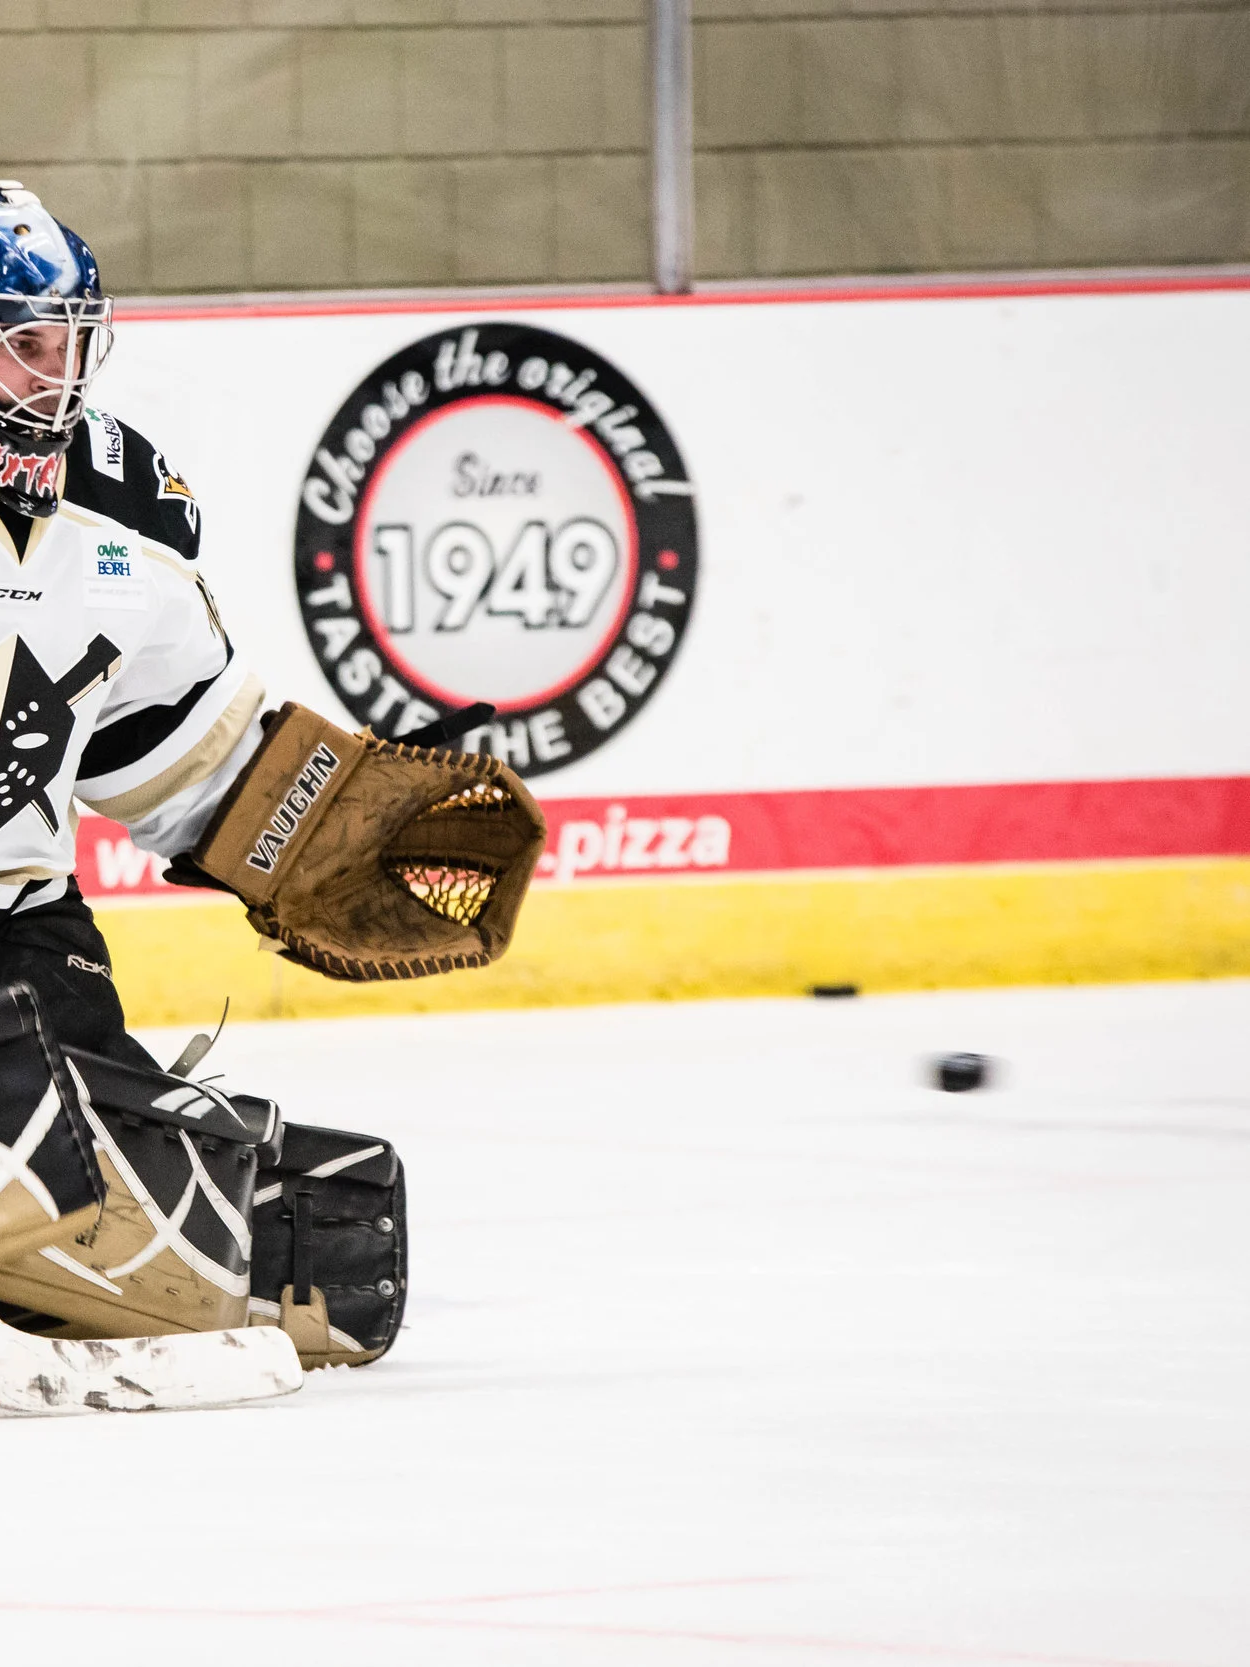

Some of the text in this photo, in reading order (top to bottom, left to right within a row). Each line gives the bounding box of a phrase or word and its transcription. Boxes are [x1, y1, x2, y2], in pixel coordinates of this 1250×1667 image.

[302, 327, 696, 525] Choose the original
[451, 450, 542, 499] Since
[97, 541, 129, 560] OVMC
[372, 518, 619, 635] 1949
[461, 708, 572, 768] THE
[576, 570, 687, 731] BEST
[246, 741, 341, 875] VAUGHN
